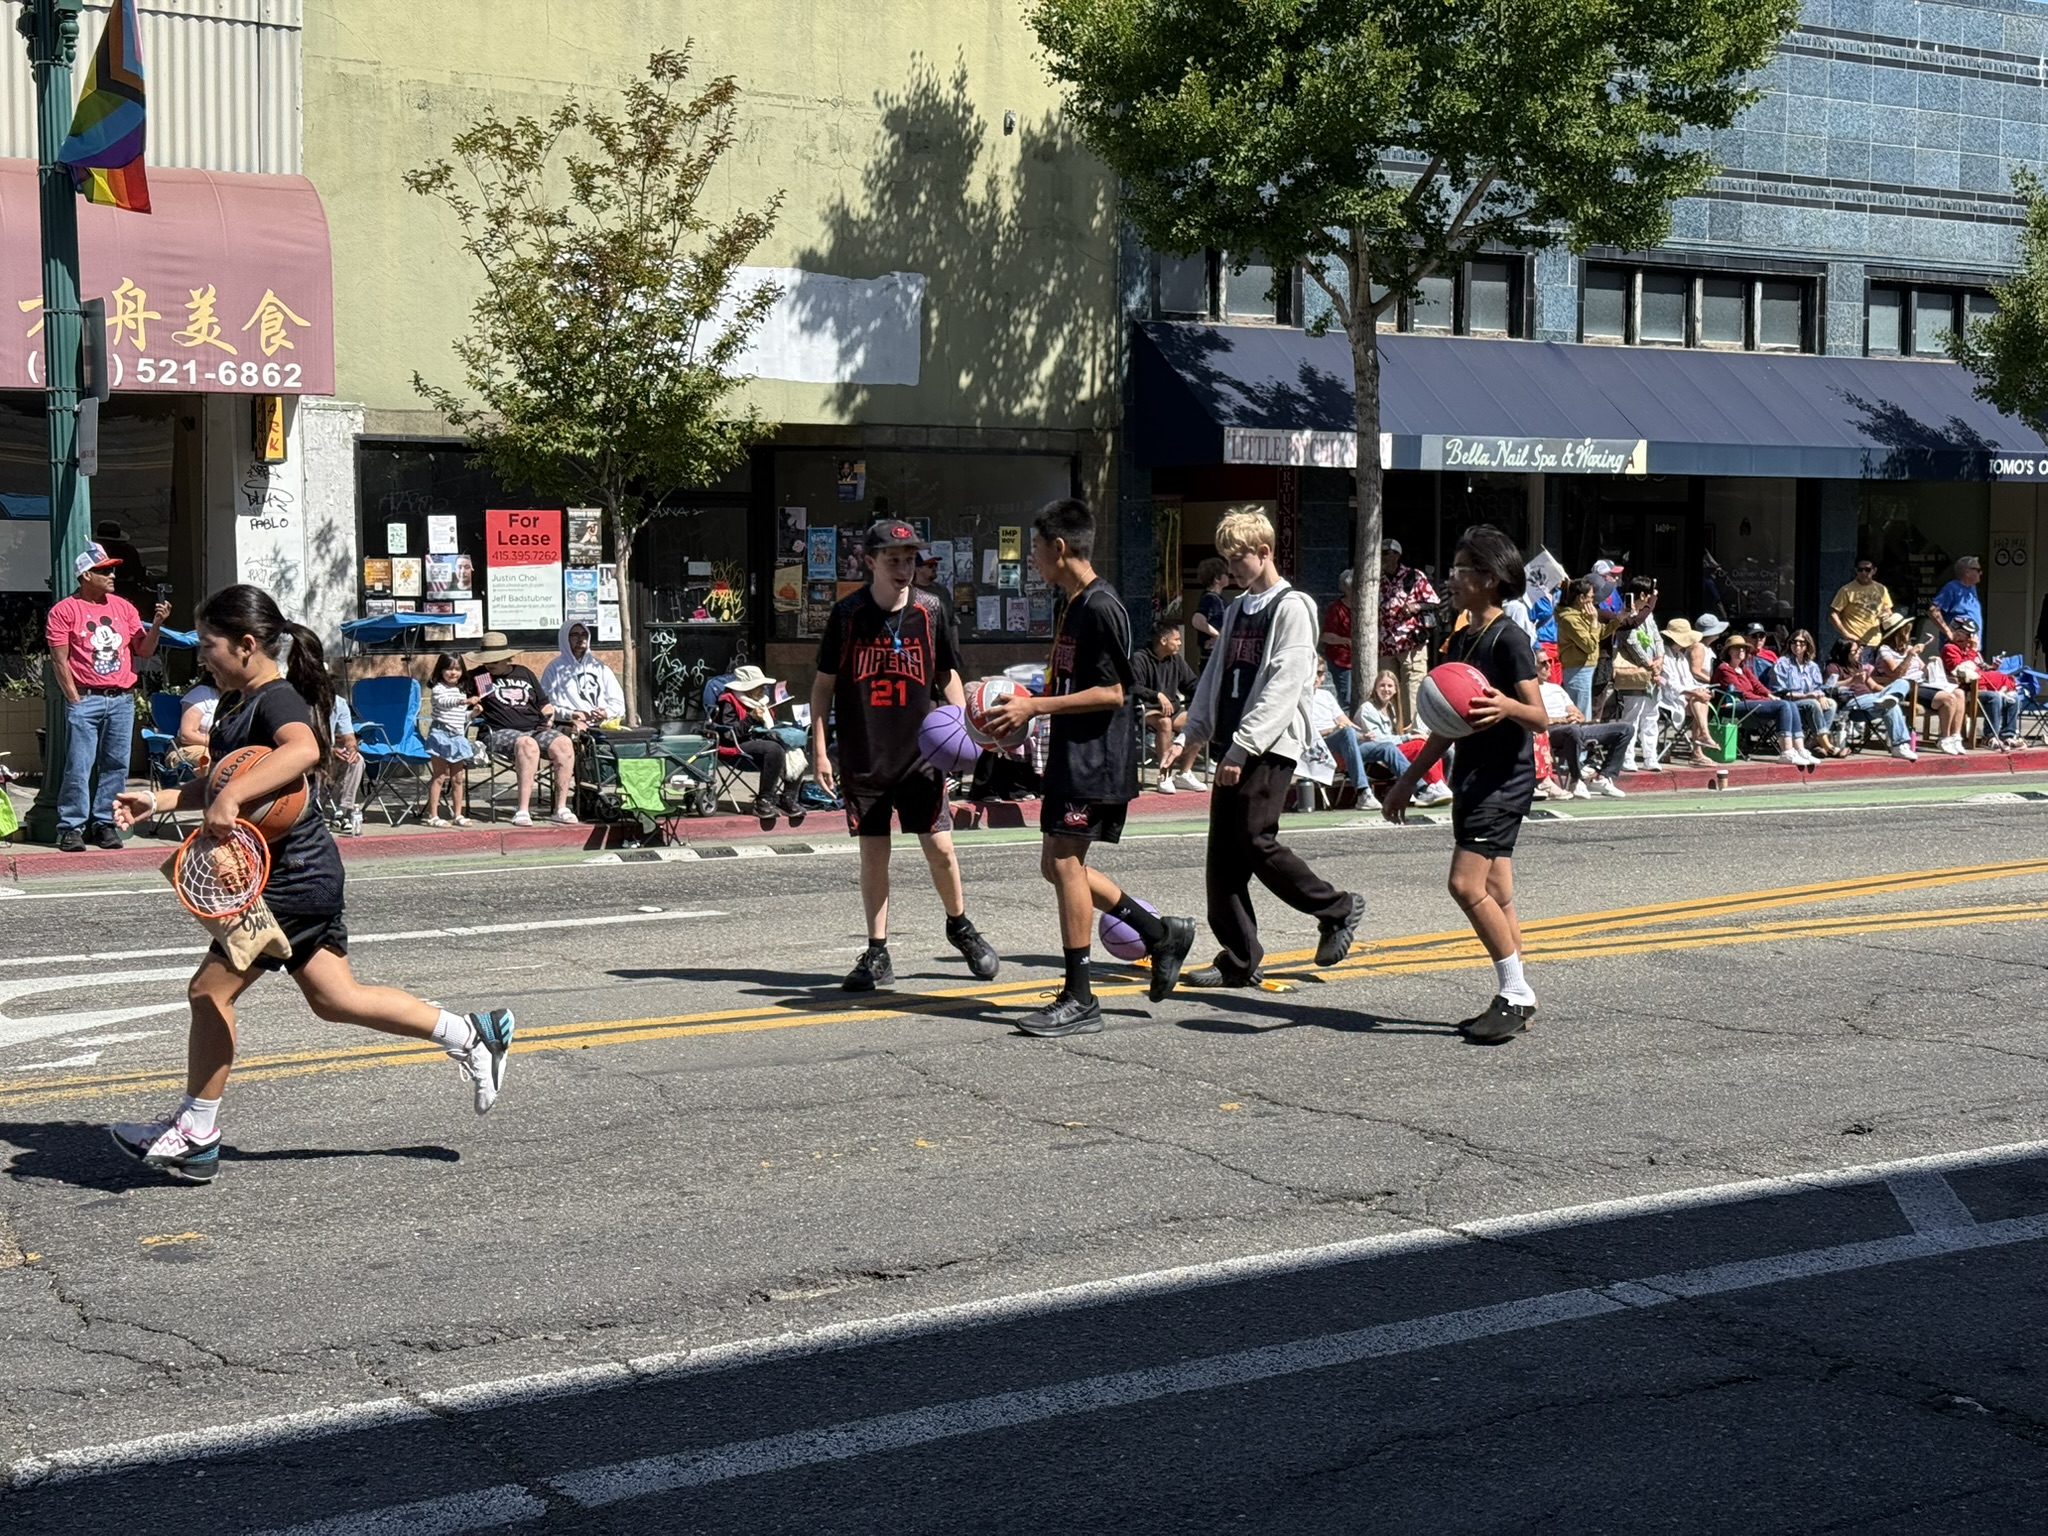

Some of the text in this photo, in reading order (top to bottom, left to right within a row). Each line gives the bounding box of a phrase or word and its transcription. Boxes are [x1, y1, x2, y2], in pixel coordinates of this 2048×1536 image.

[136, 358, 302, 388] 521-6862
[1231, 434, 1281, 461] LITTLE
[1446, 438, 1625, 473] Bella Nail Spa & Waxing
[1989, 459, 2035, 475] TOMO'S
[250, 517, 289, 530] PABLO
[509, 513, 539, 528] For
[498, 530, 551, 546] Lease
[1001, 529, 1017, 537] IMP
[492, 550, 558, 561] 415.395.7262
[492, 573, 537, 582] Justin Choi
[492, 594, 552, 602] Jeff Badstubner
[548, 617, 560, 625] JLL
[855, 637, 921, 645] ALAMDA
[853, 646, 926, 686] VIPERS
[1231, 668, 1240, 698] 1
[871, 680, 907, 706] 21
